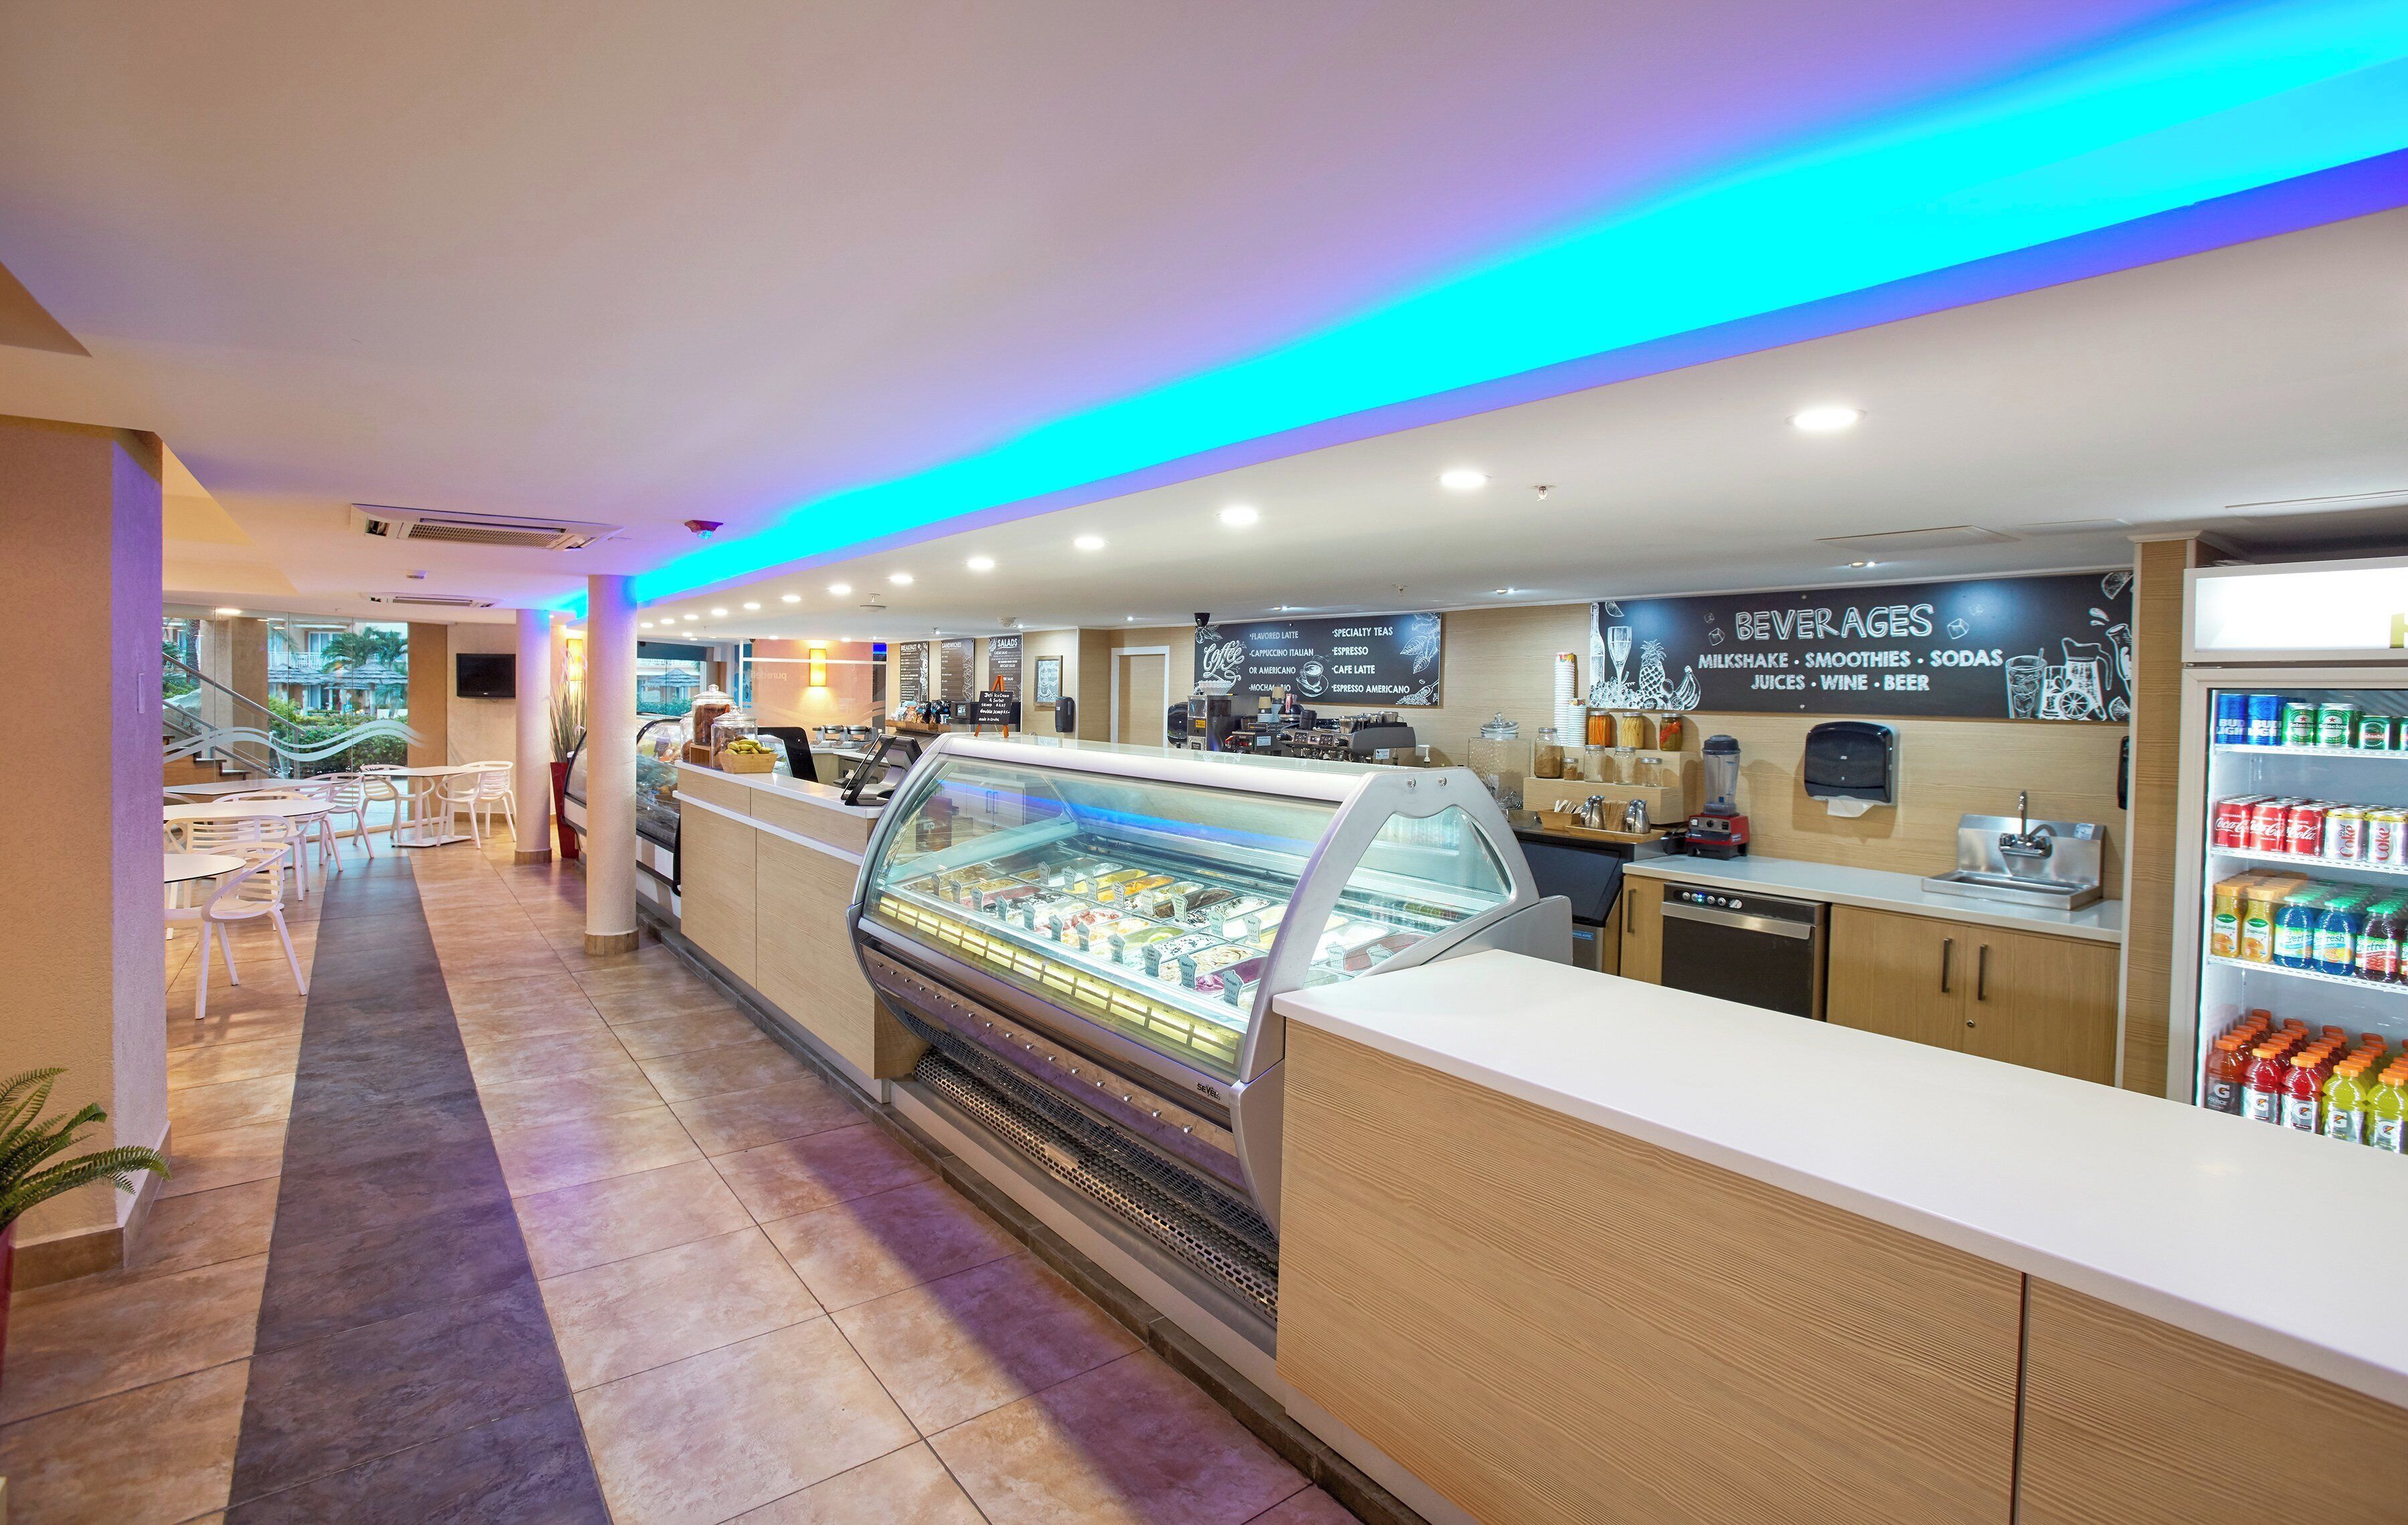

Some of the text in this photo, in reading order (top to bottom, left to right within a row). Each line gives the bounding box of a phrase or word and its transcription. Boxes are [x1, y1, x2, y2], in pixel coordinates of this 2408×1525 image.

[1735, 604, 1934, 641] BEVERAGES
[1282, 631, 1298, 639] LATTE
[1333, 627, 1393, 637] SPECIALTY TEAS
[997, 638, 1017, 647] SALADS
[1290, 648, 1314, 656] ITALIAN
[1333, 646, 1369, 655] ESPRESSO
[1698, 649, 2003, 669] MILKSHAKE SMOOTHIES SODAS
[1259, 666, 1296, 674] AMERICANO
[1333, 665, 1375, 674] CAFE LATTE
[1751, 674, 1930, 691] JUICES WINE BEER
[1333, 684, 1410, 694] ESPRESSO AMERICANO
[2219, 719, 2245, 727] BUD
[2213, 1084, 2230, 1098] G
[2292, 1103, 2313, 1120] G
[2329, 1110, 2347, 1128] G
